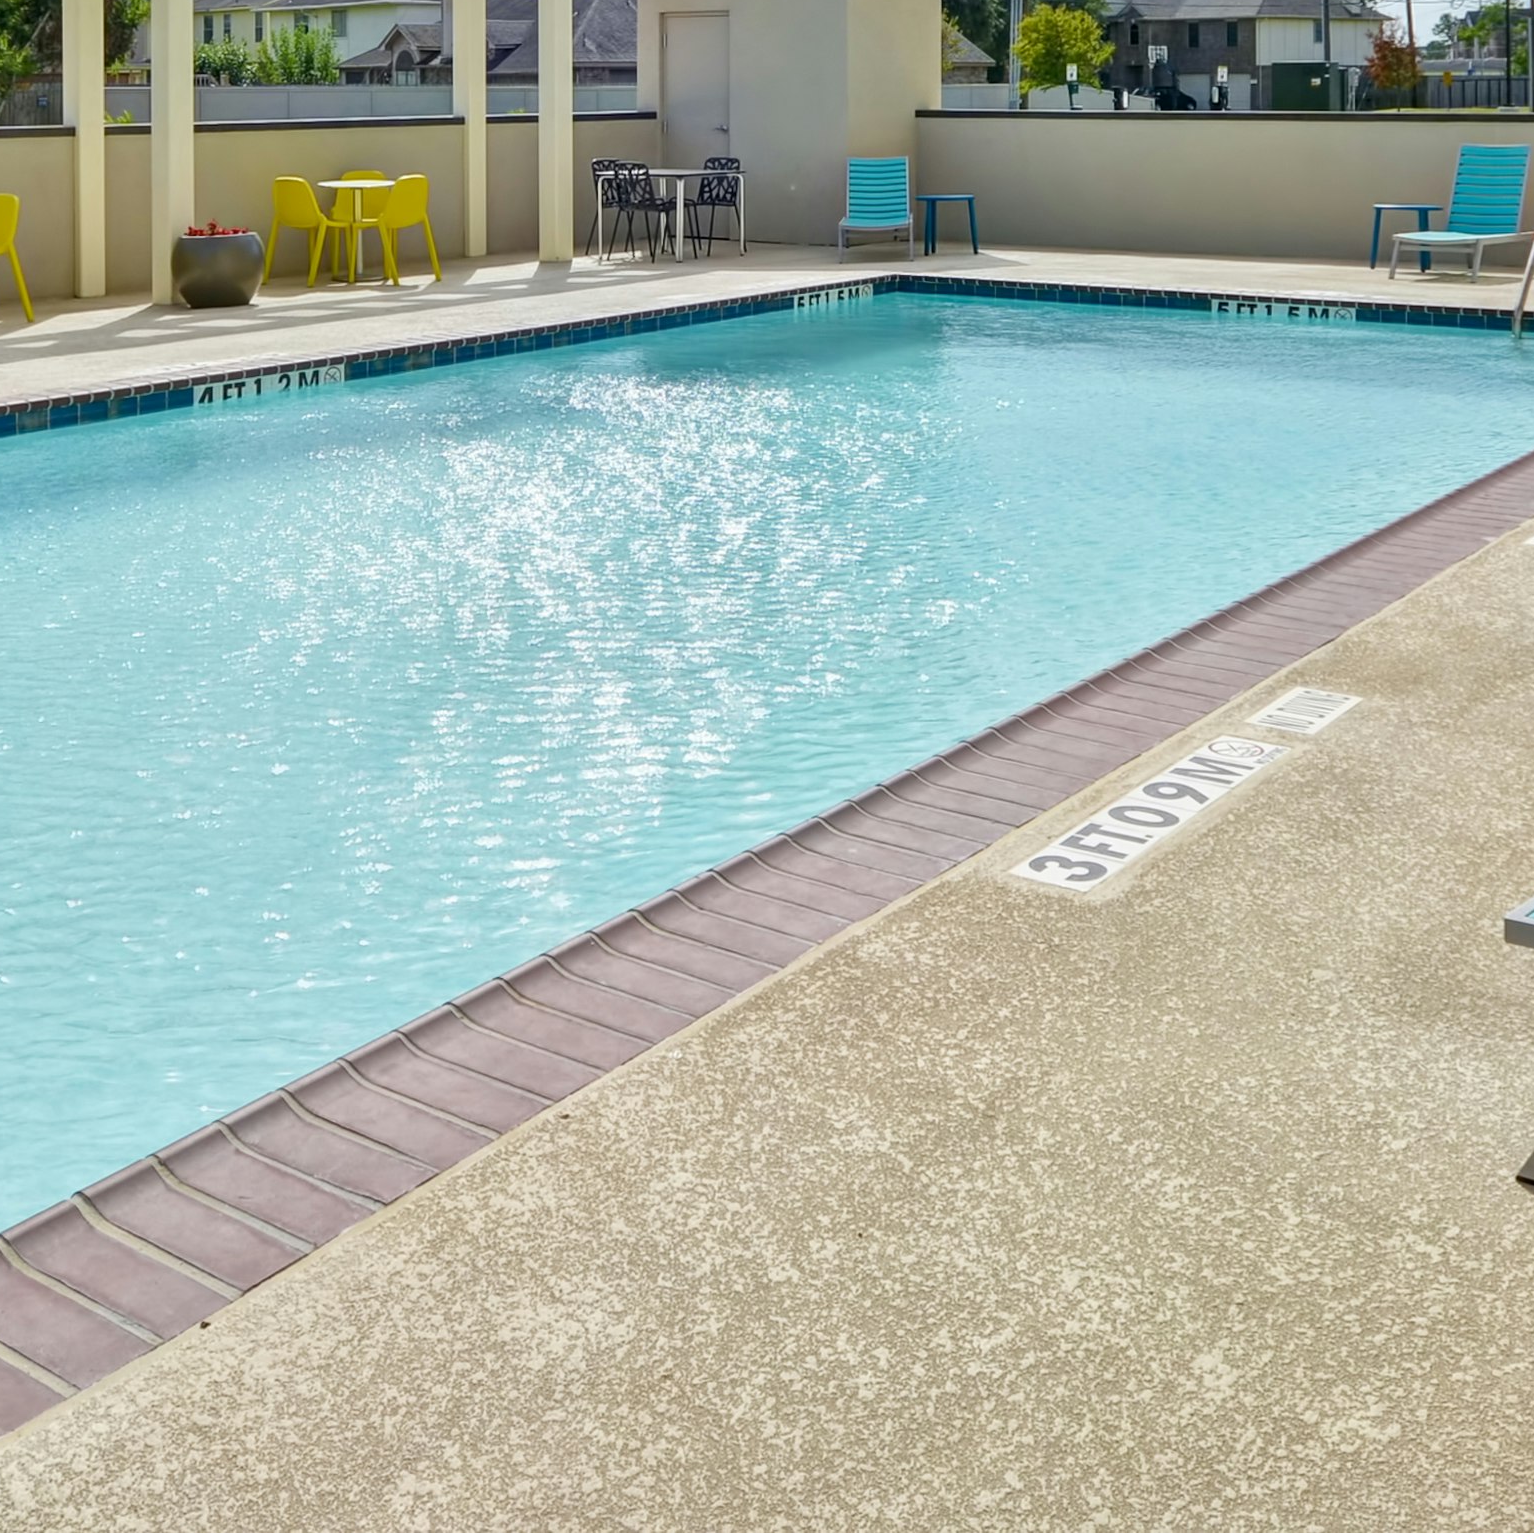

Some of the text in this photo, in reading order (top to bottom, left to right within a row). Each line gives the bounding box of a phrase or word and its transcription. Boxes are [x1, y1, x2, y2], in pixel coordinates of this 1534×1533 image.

[1257, 714, 1315, 733] NO
[1029, 855, 1108, 882] 3
[1169, 756, 1255, 785] M
